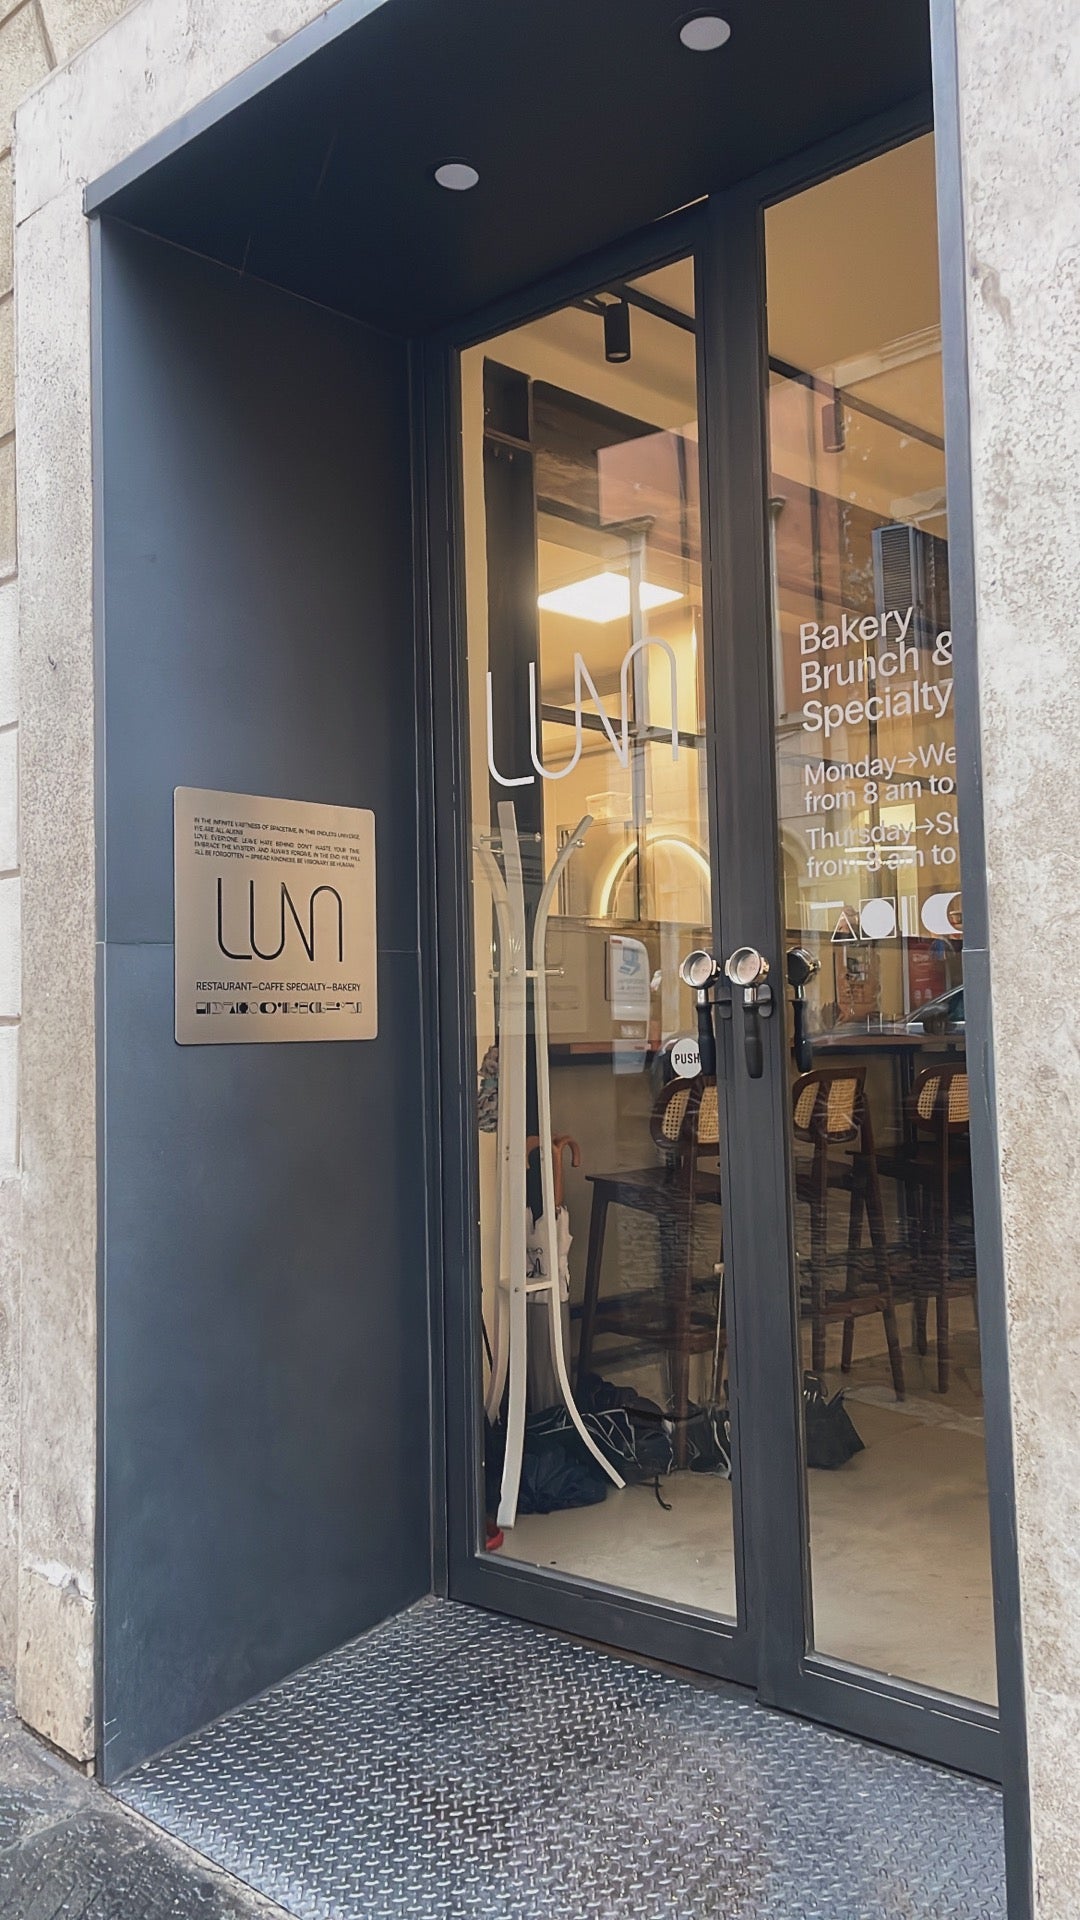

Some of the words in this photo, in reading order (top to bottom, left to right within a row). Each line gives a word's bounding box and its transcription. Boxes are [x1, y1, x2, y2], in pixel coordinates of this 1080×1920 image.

[800, 606, 913, 655] Bakery
[801, 642, 919, 694] Brunch
[932, 631, 952, 666] &
[802, 679, 953, 738] Specialty
[804, 754, 897, 786] Monday
[804, 791, 856, 813] from
[863, 782, 879, 804] 8
[885, 780, 922, 801] am
[928, 774, 954, 795] to
[805, 820, 914, 850] Thursday
[931, 844, 956, 866] to
[674, 1052, 700, 1064] PUSH
